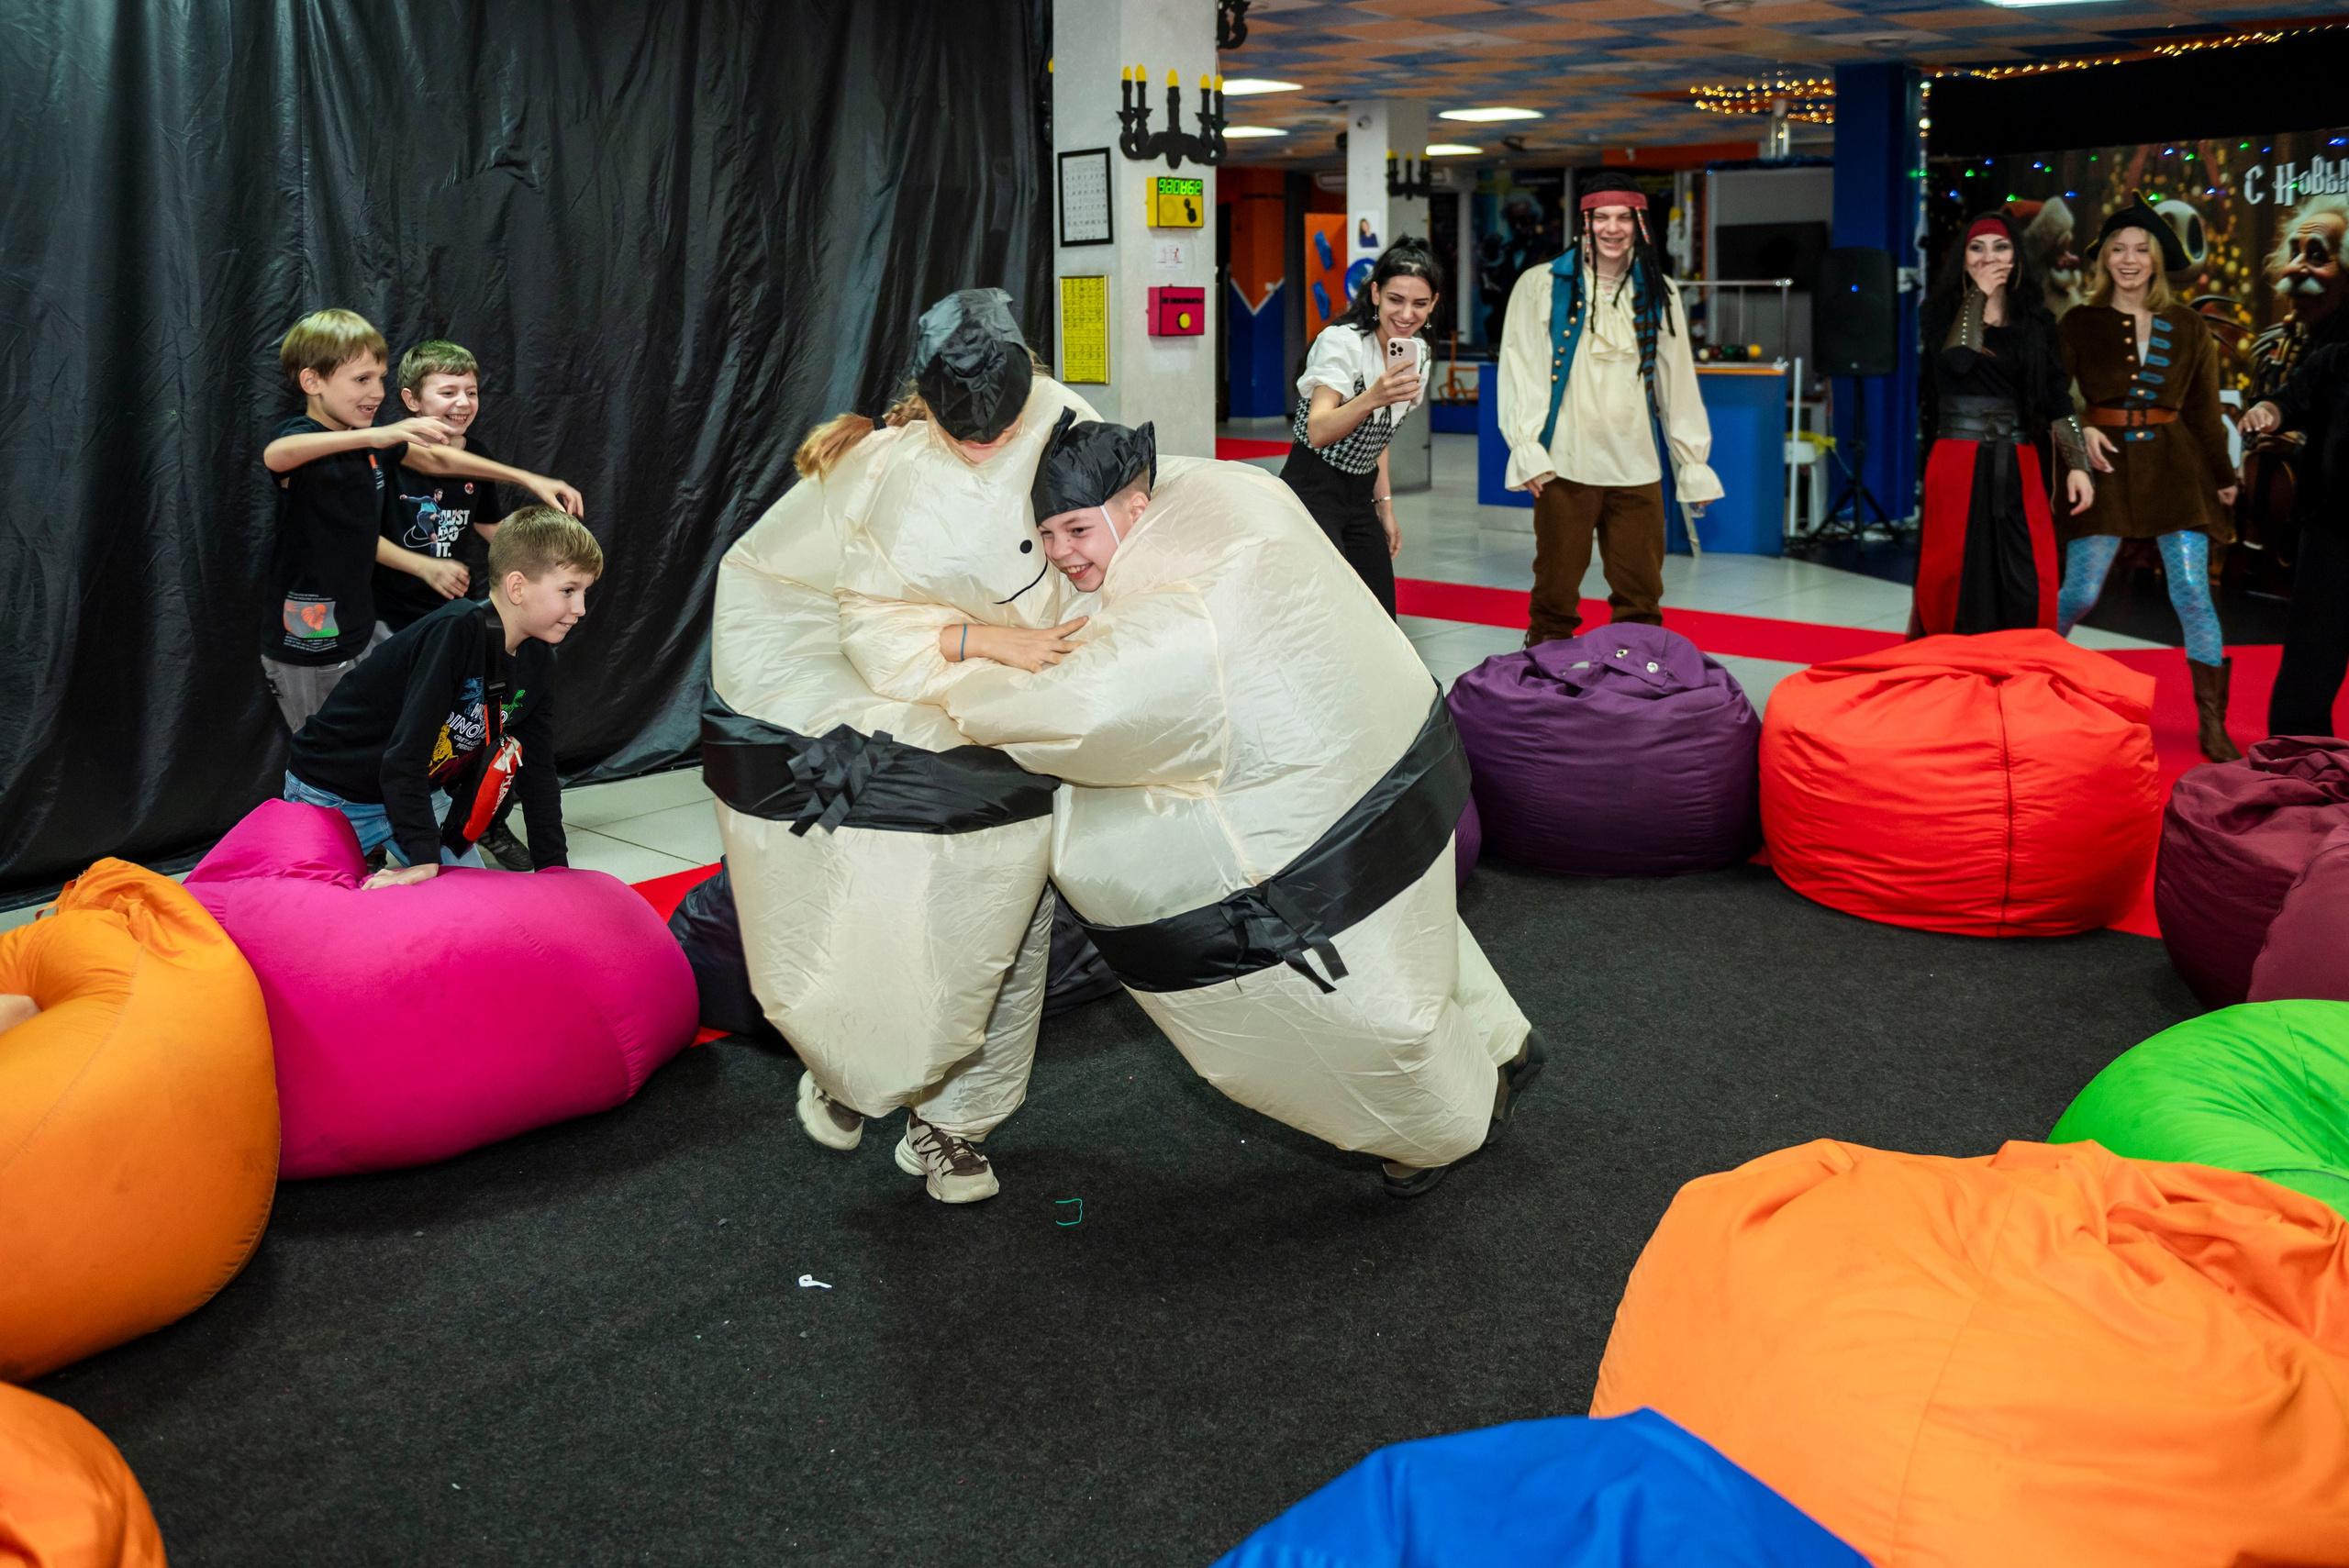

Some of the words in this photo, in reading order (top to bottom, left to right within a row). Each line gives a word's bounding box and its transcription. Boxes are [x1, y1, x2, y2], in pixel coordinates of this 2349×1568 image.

[439, 509, 470, 526] JUST
[437, 526, 460, 541] DO
[436, 542, 451, 557] IT.
